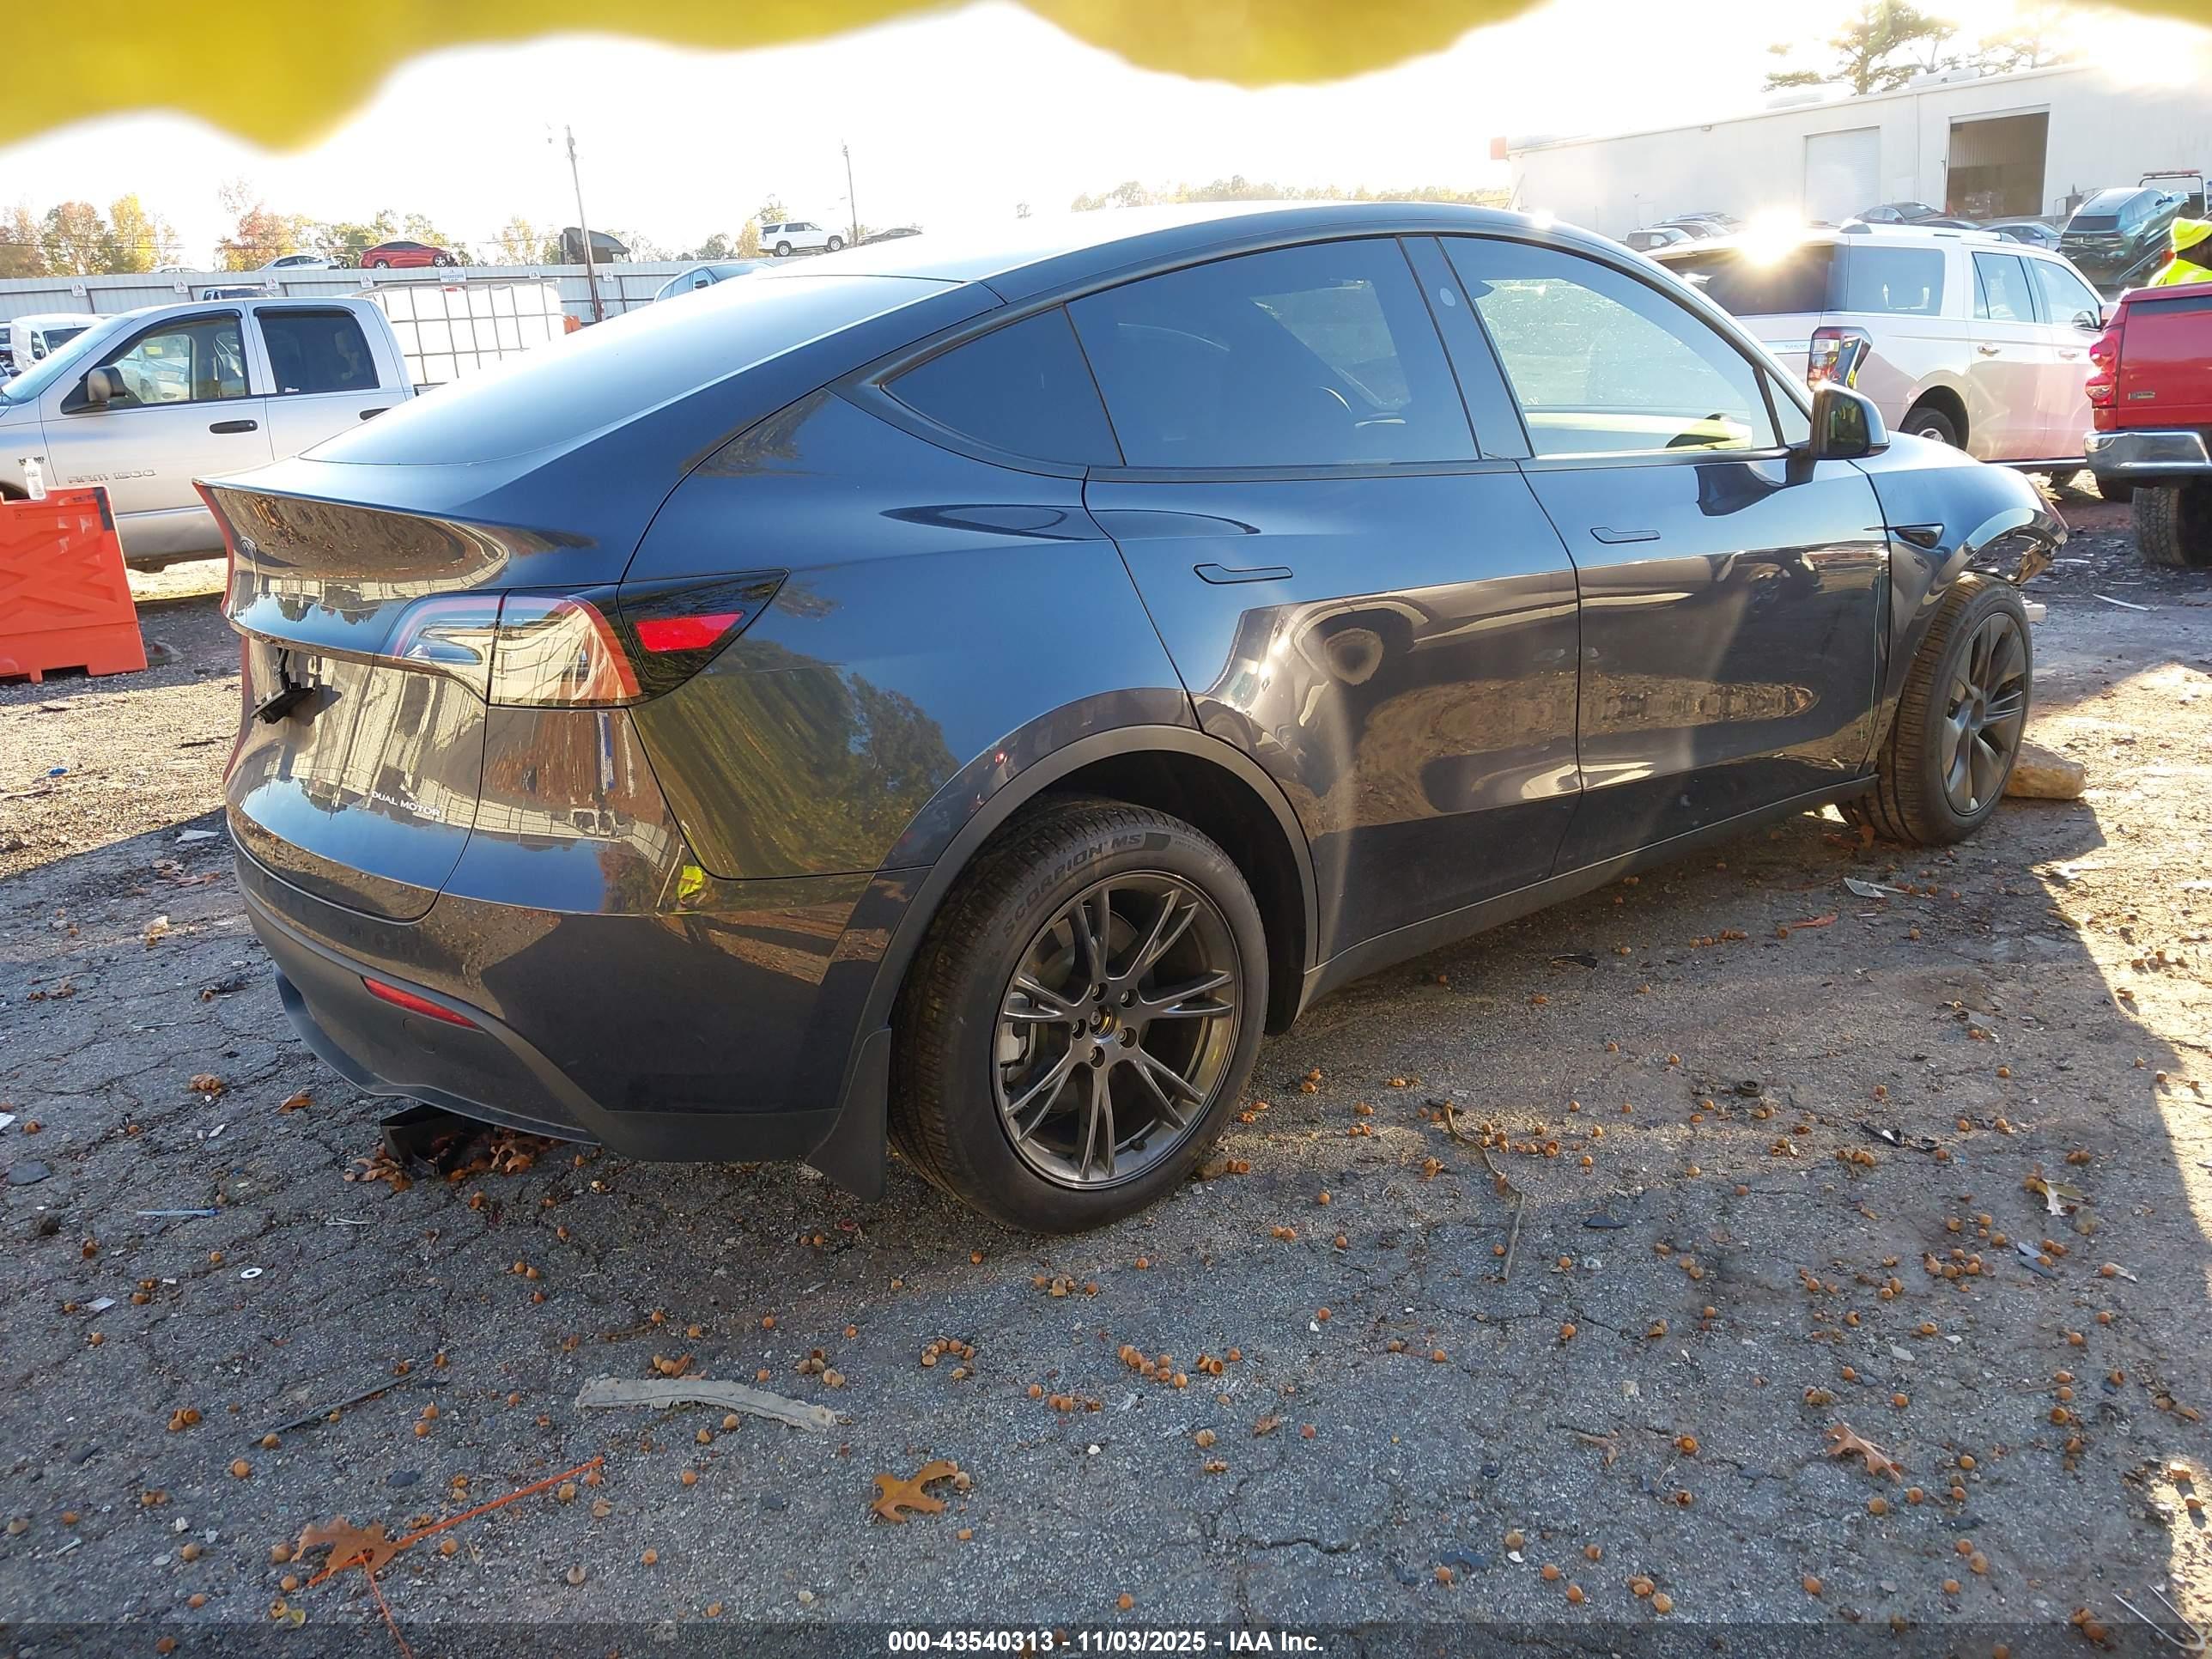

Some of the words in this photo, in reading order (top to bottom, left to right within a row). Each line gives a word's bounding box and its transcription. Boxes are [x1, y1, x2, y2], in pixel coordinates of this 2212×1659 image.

[66, 473, 109, 483] RAM
[112, 469, 157, 480] 1500
[371, 790, 398, 805] DUAL
[399, 799, 441, 817] MOTOR
[1001, 842, 1103, 939] SCORPION
[1111, 833, 1142, 849] MS
